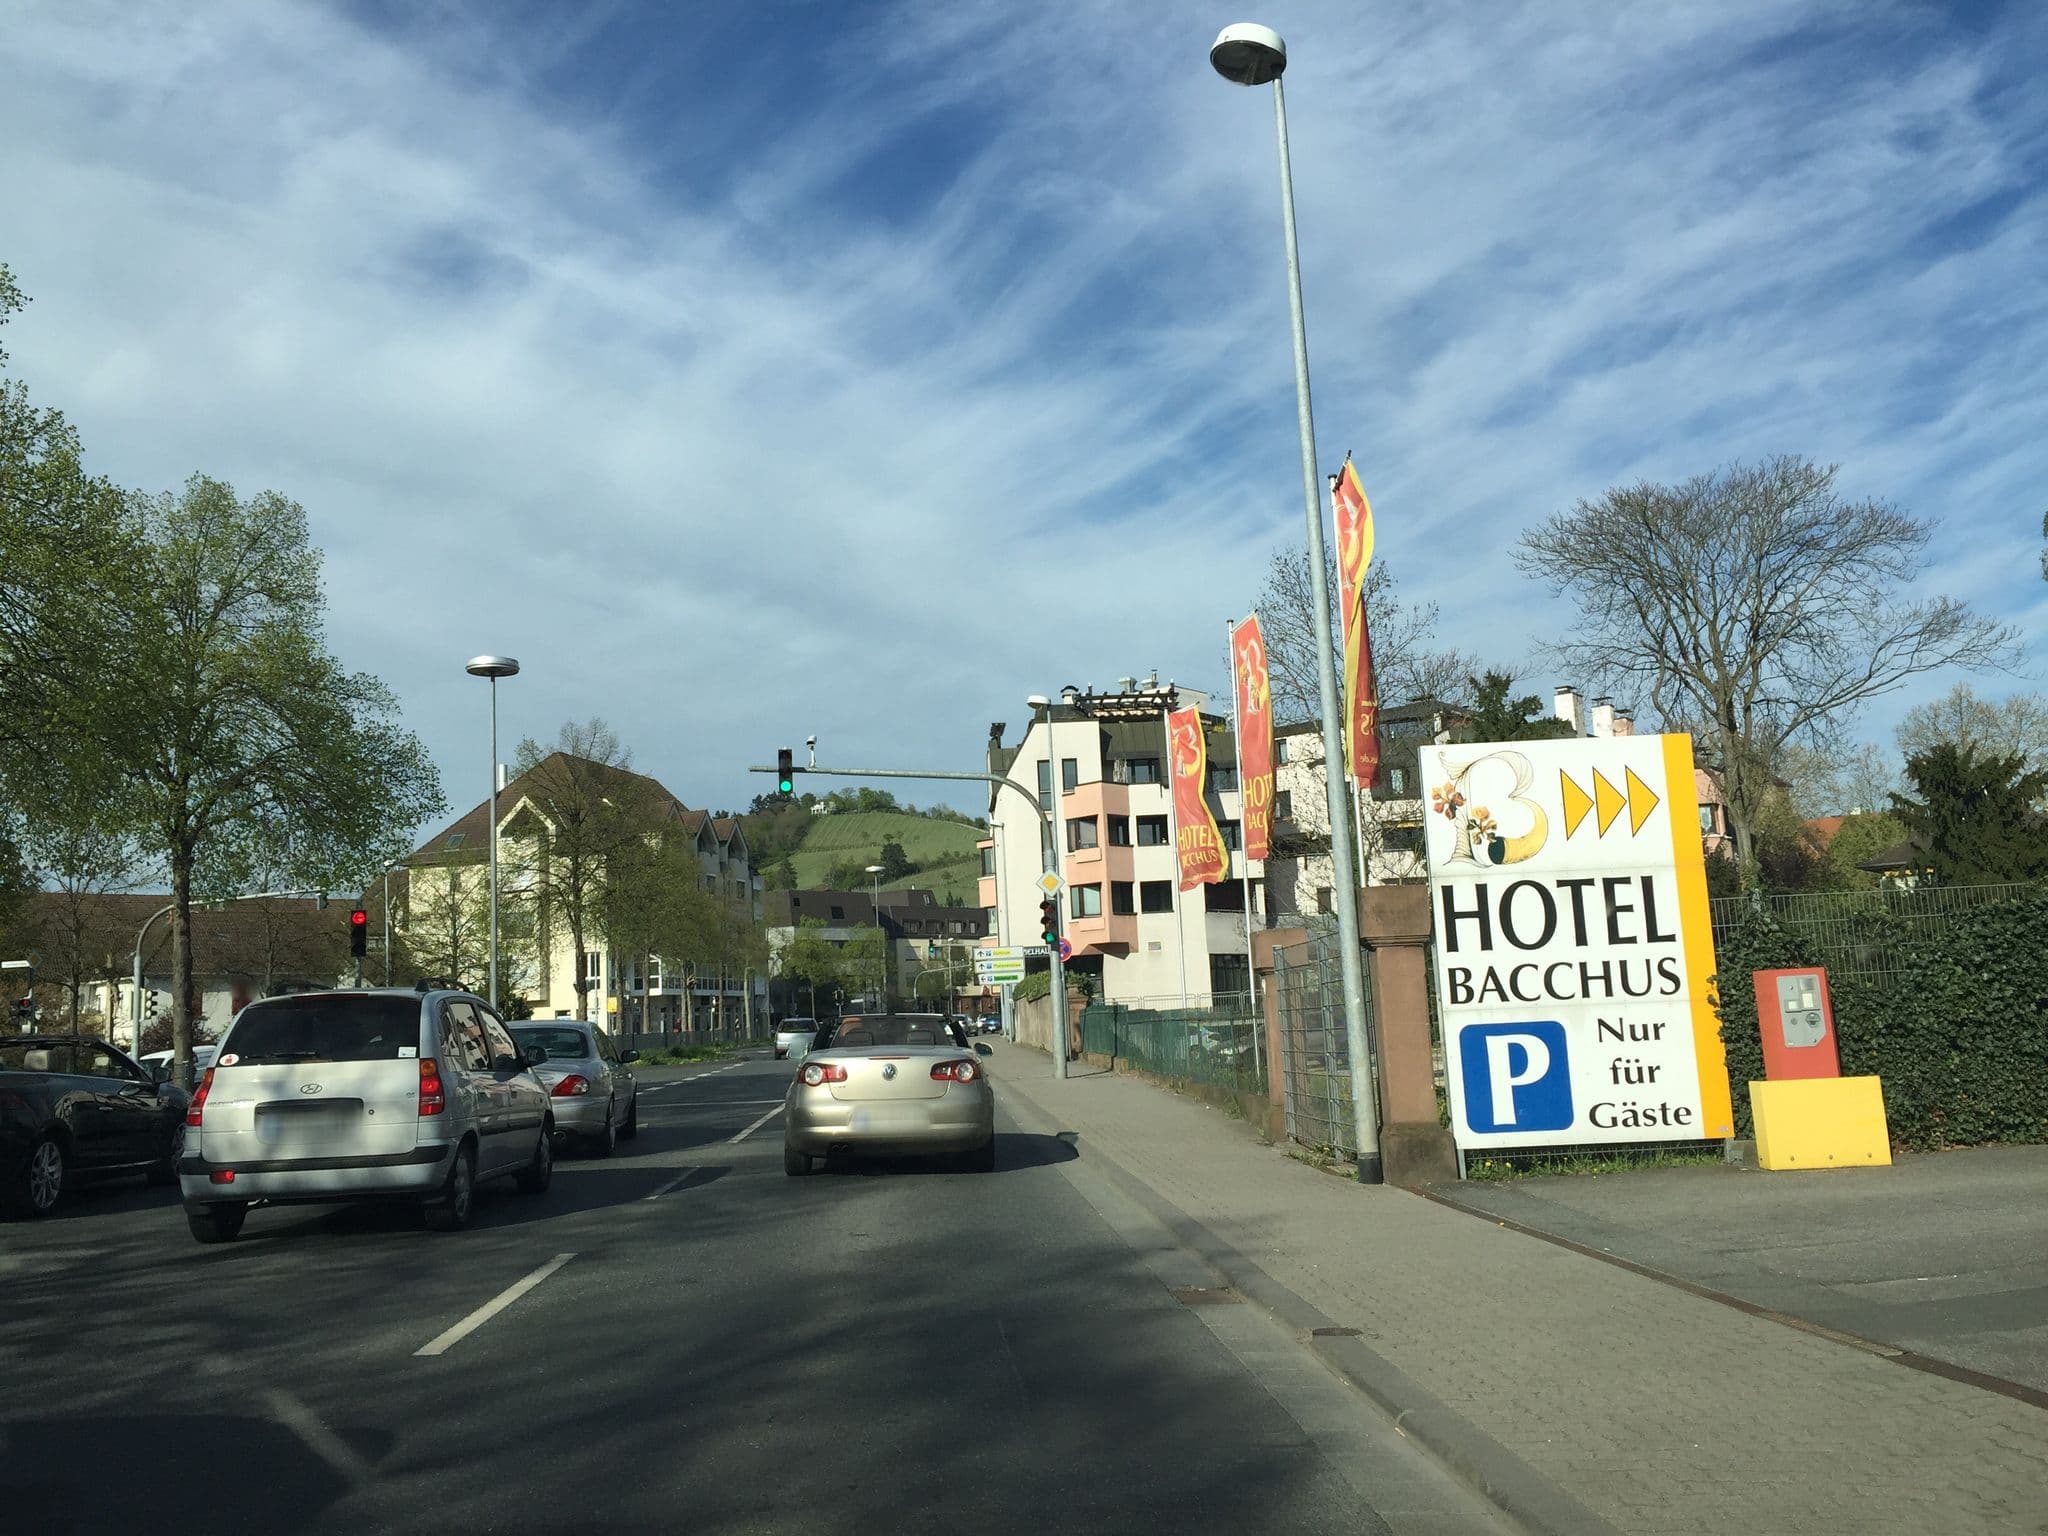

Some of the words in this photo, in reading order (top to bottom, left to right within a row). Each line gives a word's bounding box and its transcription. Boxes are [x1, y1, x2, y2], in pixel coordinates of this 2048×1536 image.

[1178, 824, 1214, 851] HOTEL
[1440, 875, 1677, 953] HOTEL
[1448, 956, 1681, 1005] BACCHUS
[1598, 1017, 1666, 1043] Nur
[1485, 1033, 1551, 1126] P
[1609, 1056, 1661, 1085] für
[1589, 1100, 1693, 1129] Gäste
